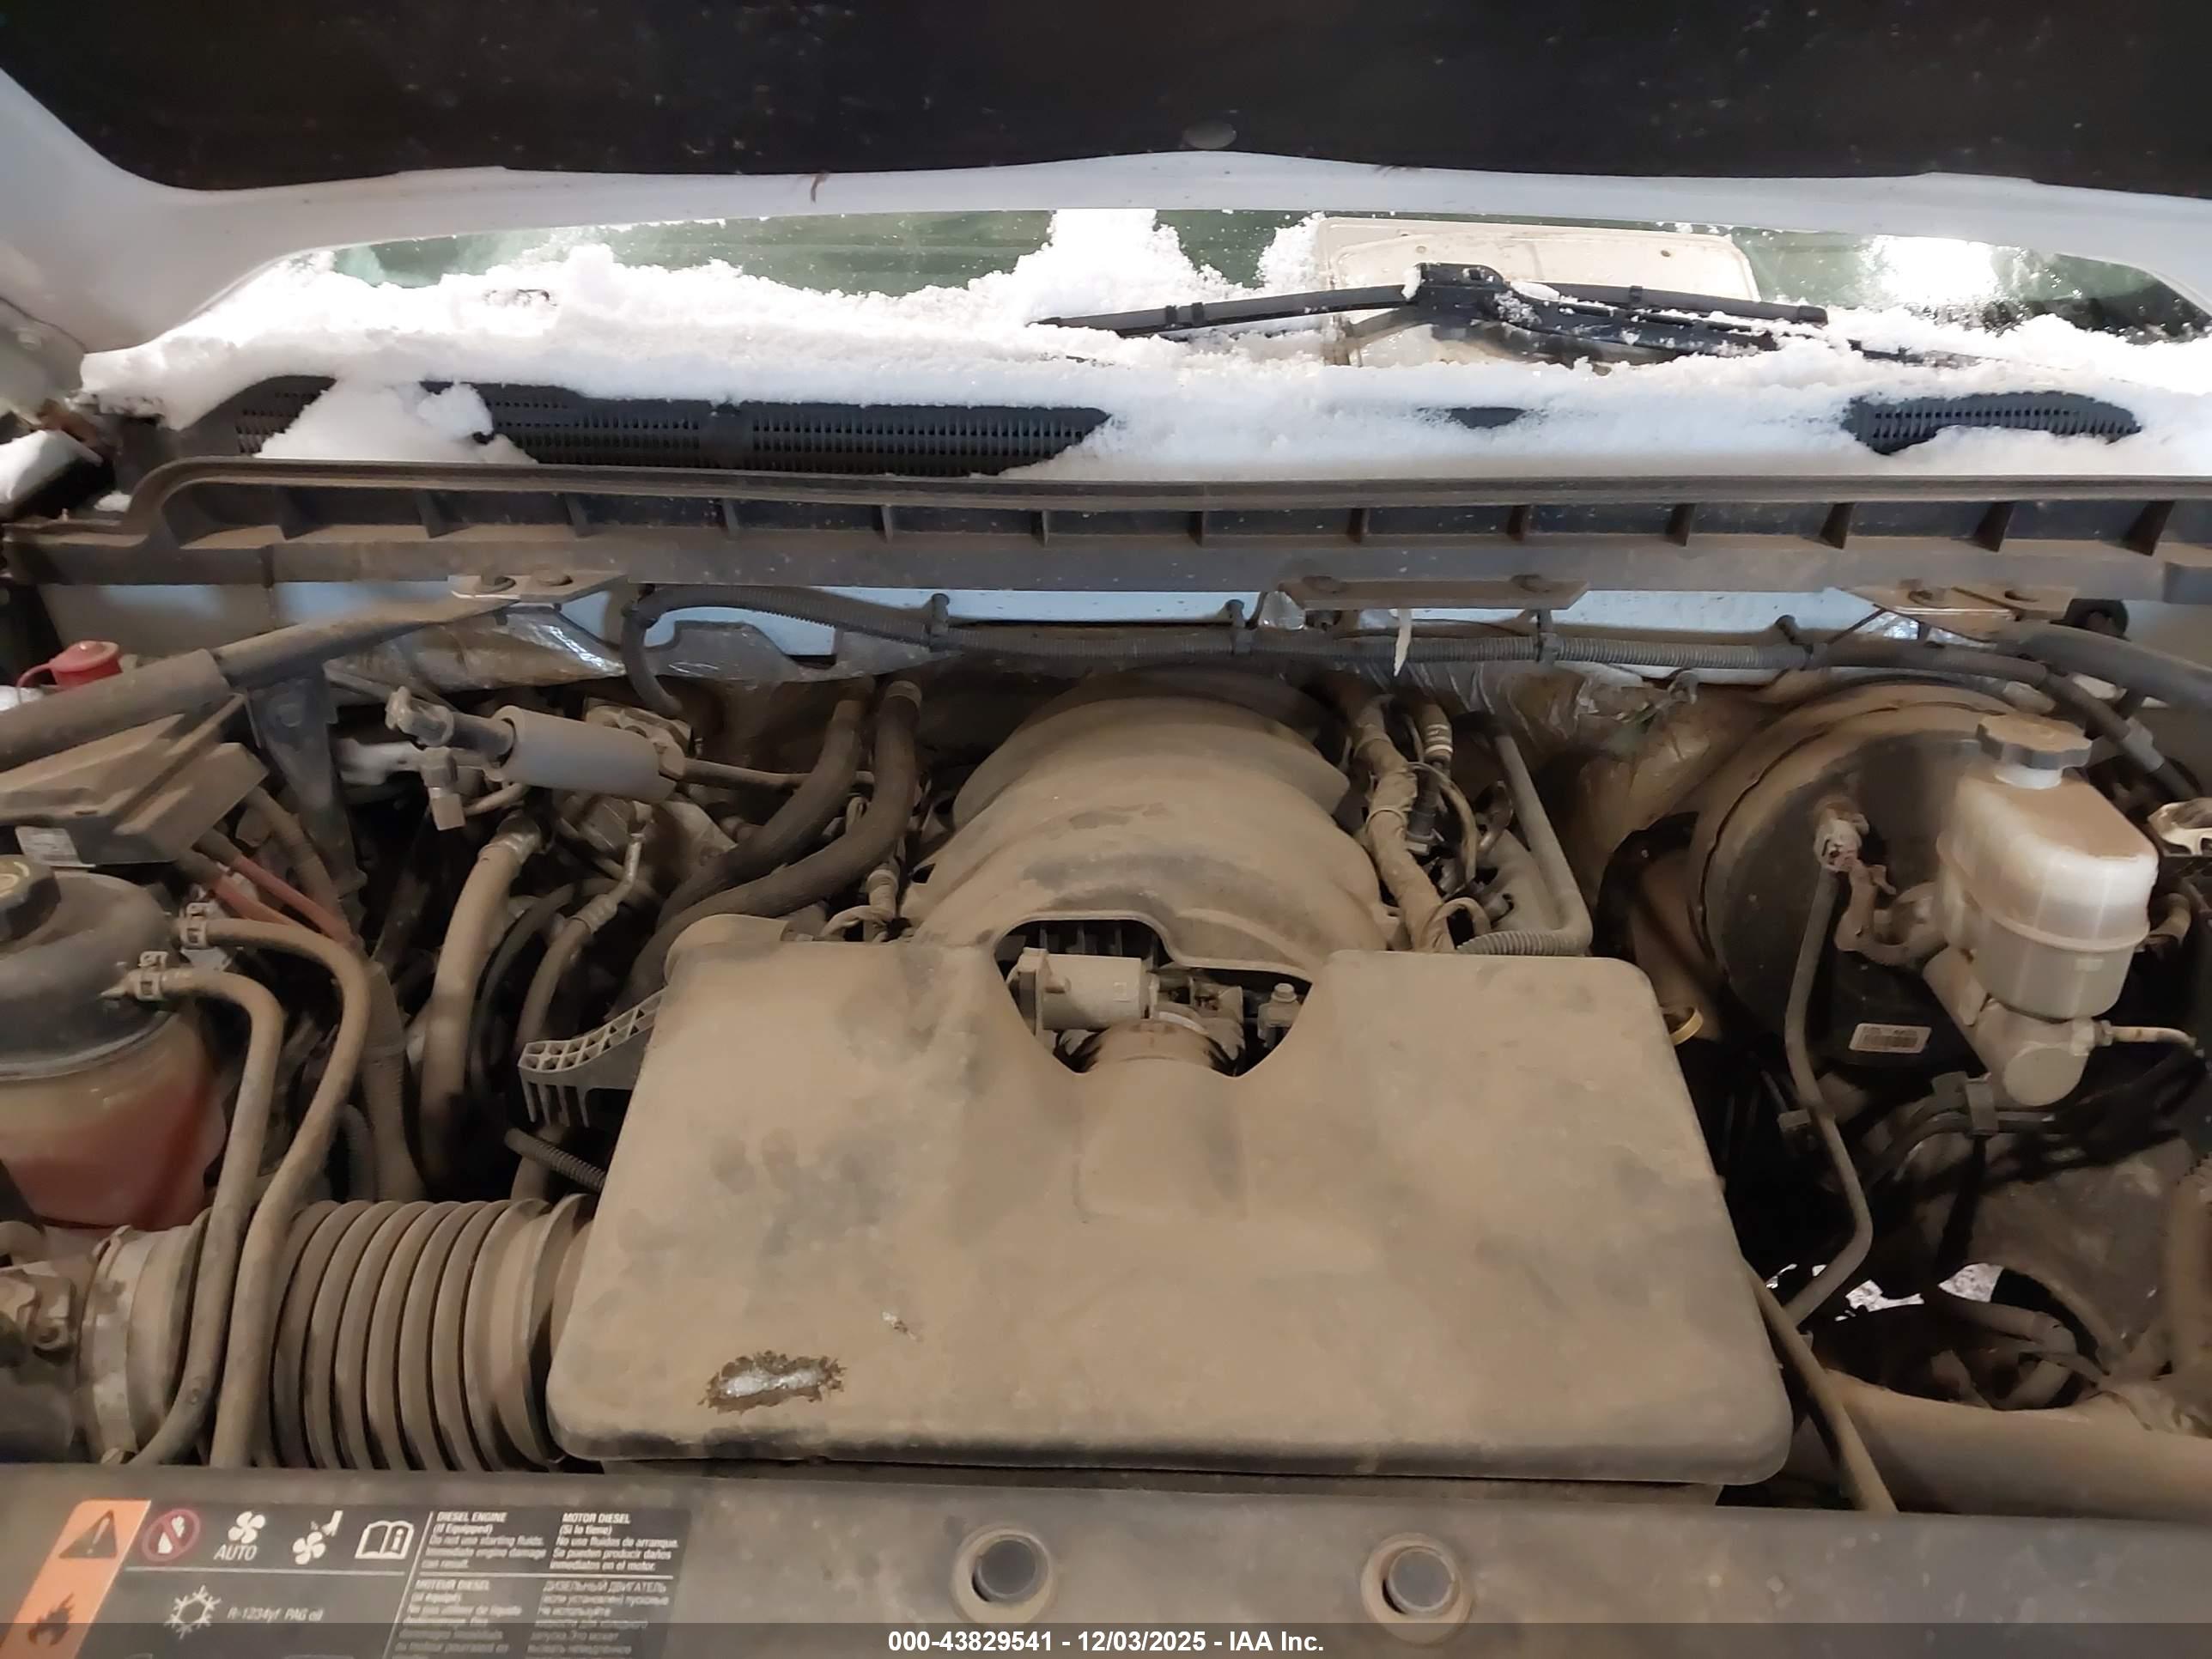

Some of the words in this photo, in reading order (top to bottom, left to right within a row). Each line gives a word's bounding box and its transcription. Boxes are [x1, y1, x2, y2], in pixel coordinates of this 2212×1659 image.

[436, 1511, 470, 1522] DIESEL
[471, 1511, 507, 1522] ENGINE
[562, 1513, 597, 1523] MOTOR
[598, 1513, 631, 1524] DIESEL
[213, 1544, 258, 1561] AUTO
[284, 1607, 308, 1621] PAG
[308, 1608, 324, 1621] oil
